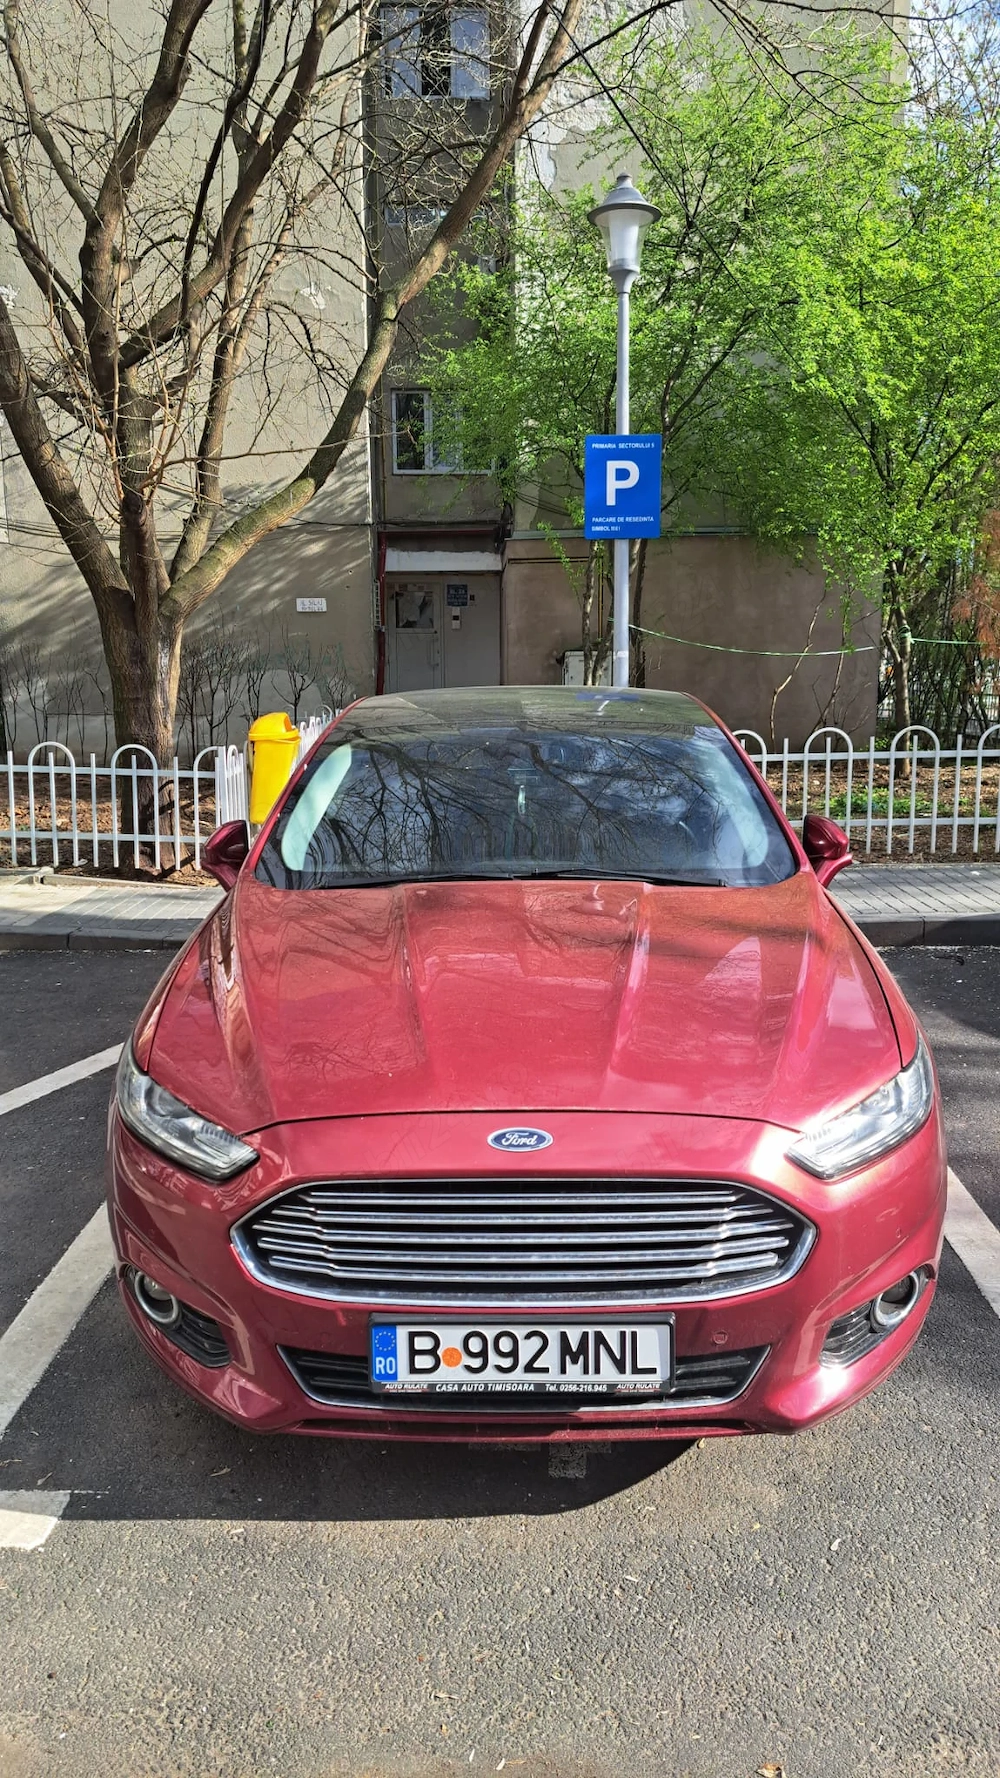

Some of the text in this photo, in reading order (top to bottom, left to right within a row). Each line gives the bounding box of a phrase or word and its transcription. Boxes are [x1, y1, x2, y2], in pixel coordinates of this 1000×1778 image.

[606, 460, 640, 506] P
[501, 1131, 538, 1146] Ford
[408, 1330, 657, 1375] B 992 MNL
[375, 1357, 396, 1375] RO
[435, 1383, 535, 1392] CASA AUTO TIMISOARA
[545, 1383, 558, 1392] Tel.
